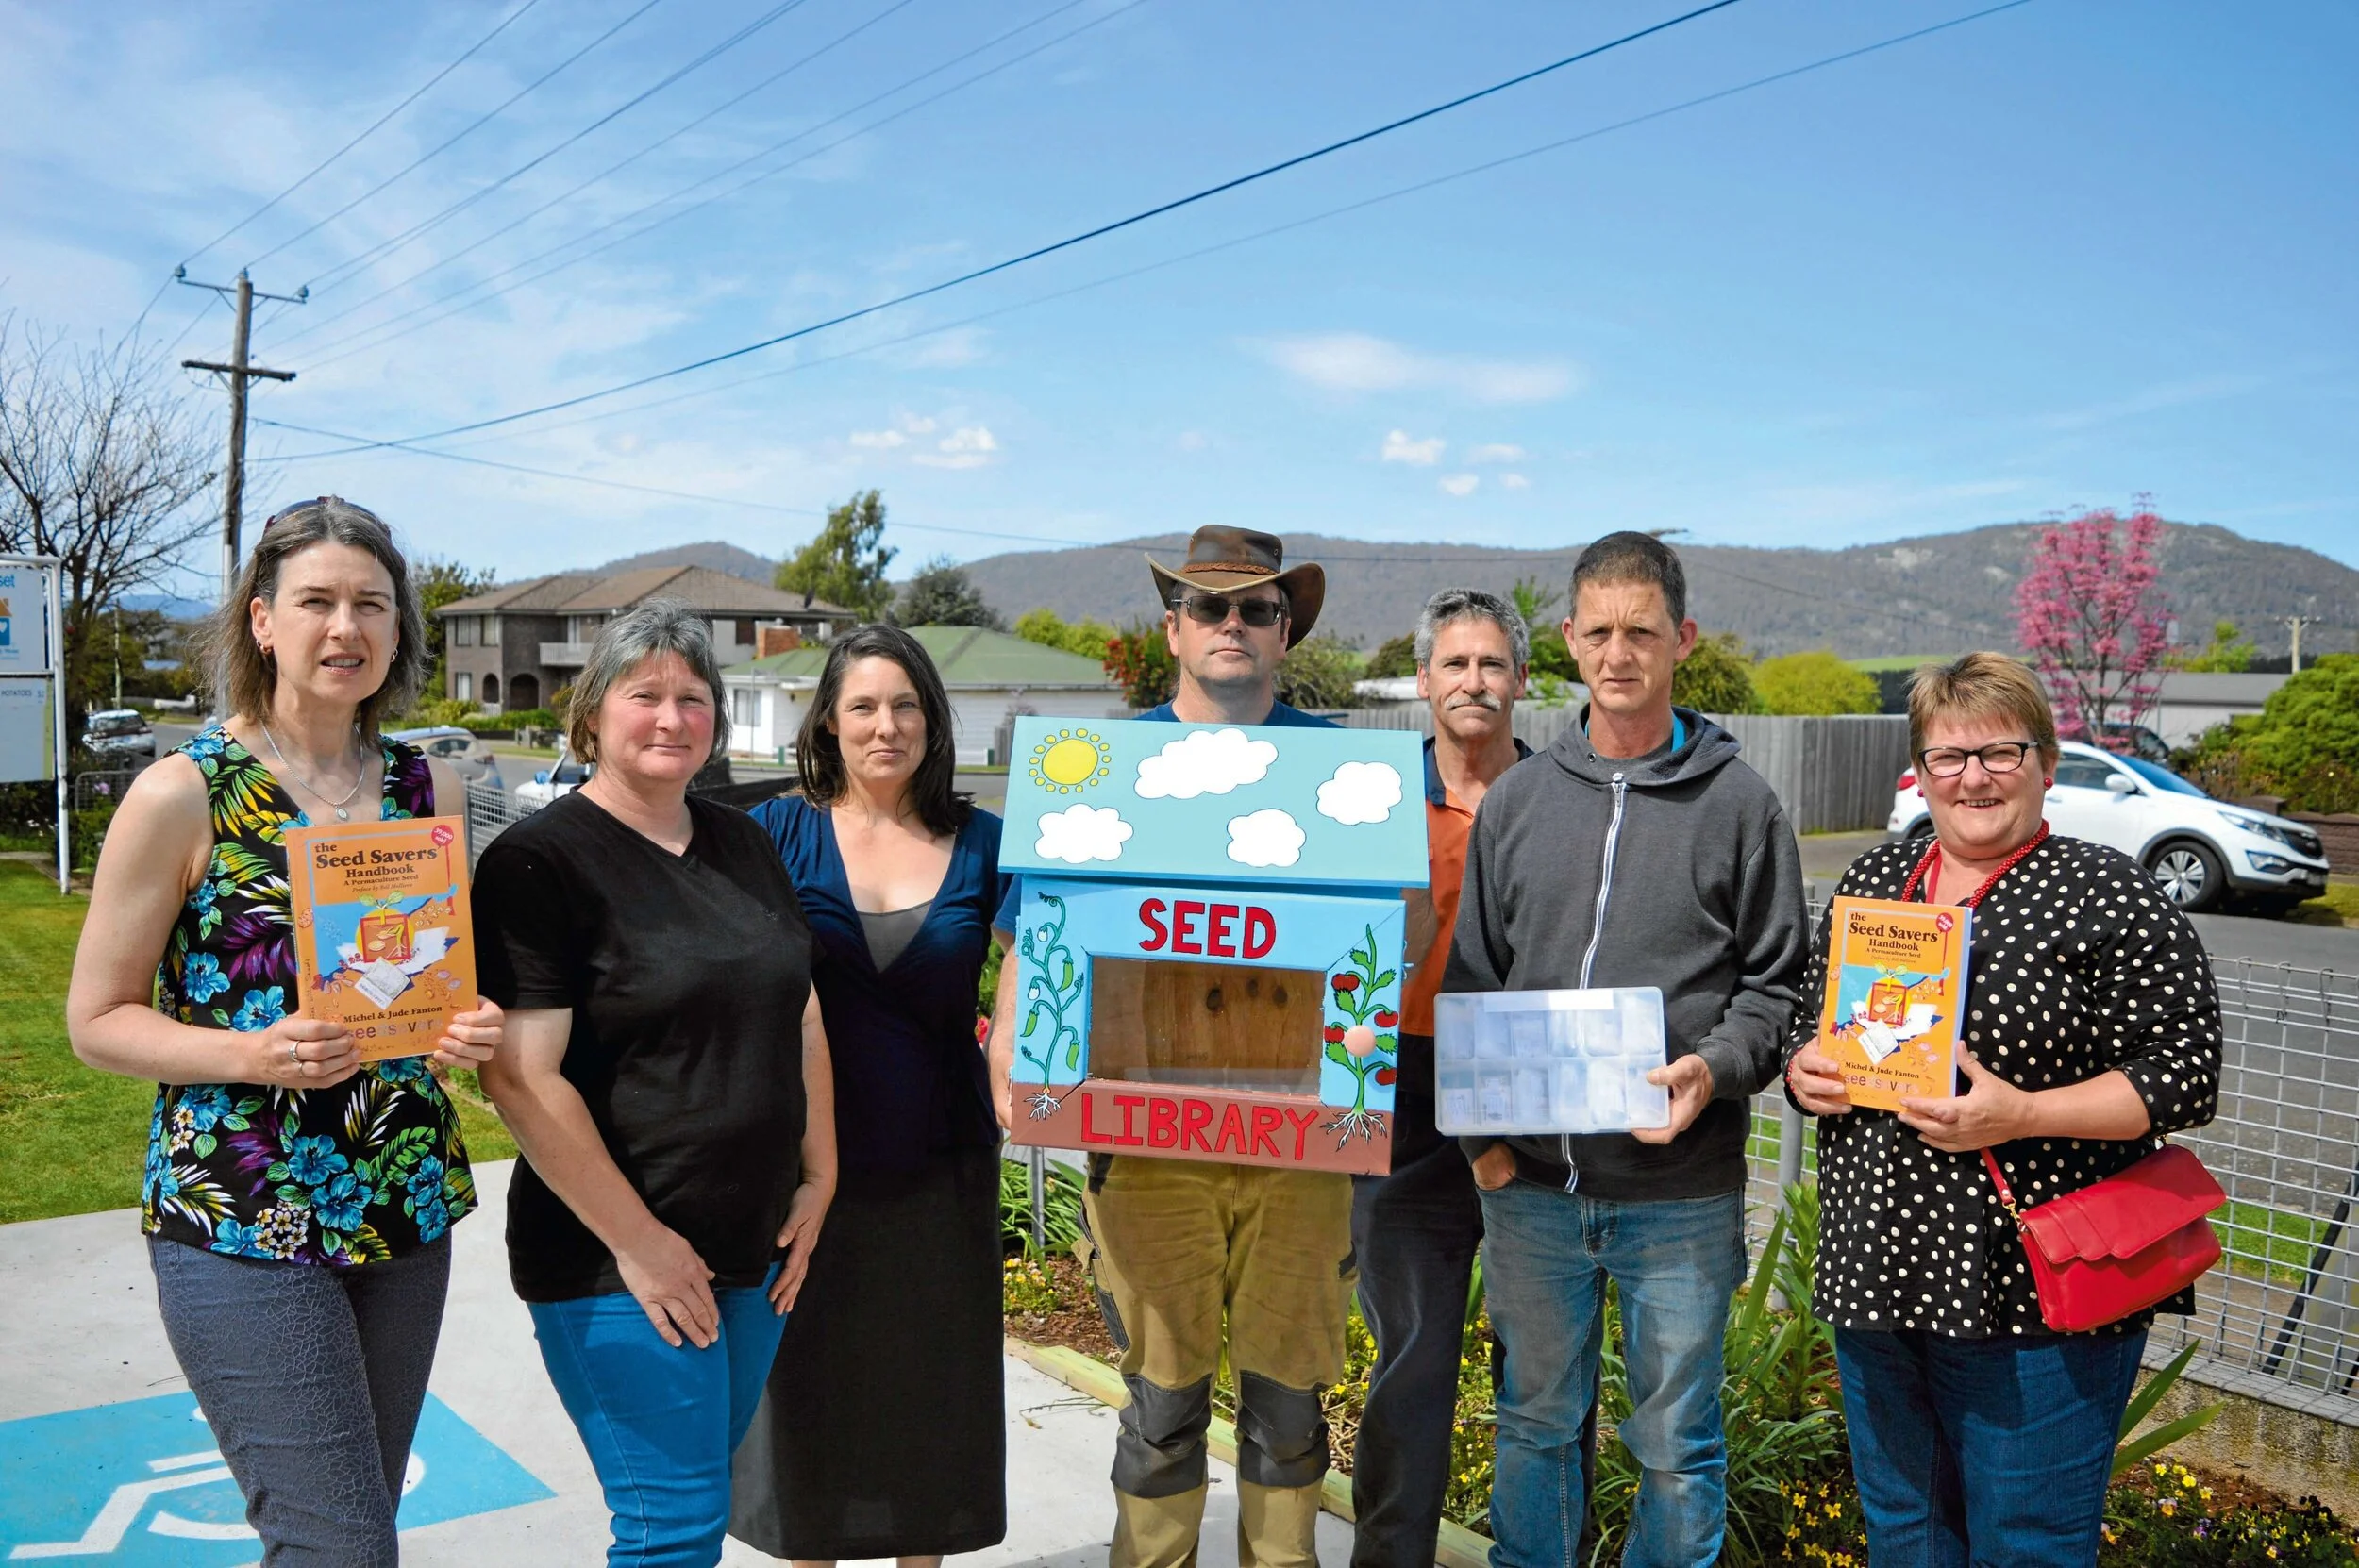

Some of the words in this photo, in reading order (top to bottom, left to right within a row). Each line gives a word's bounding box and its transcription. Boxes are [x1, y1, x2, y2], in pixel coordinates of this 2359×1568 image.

[314, 842, 337, 853] the
[316, 850, 366, 869] Seed
[346, 863, 414, 878] Handbook
[351, 876, 400, 886] Permaculture
[1850, 912, 1866, 922] the
[1138, 897, 1277, 959] SEED
[1849, 921, 1885, 937] Seed
[1868, 938, 1919, 951] Handbook
[1871, 947, 1907, 957] Permaculture
[343, 1012, 376, 1024] Michel
[388, 1009, 410, 1020] Jude
[411, 1006, 443, 1015] Fanton
[1845, 1061, 1867, 1071] Michel
[1876, 1067, 1893, 1076] Jude
[1895, 1069, 1920, 1079] Fanton
[1080, 1093, 1320, 1161] LIBRARY
